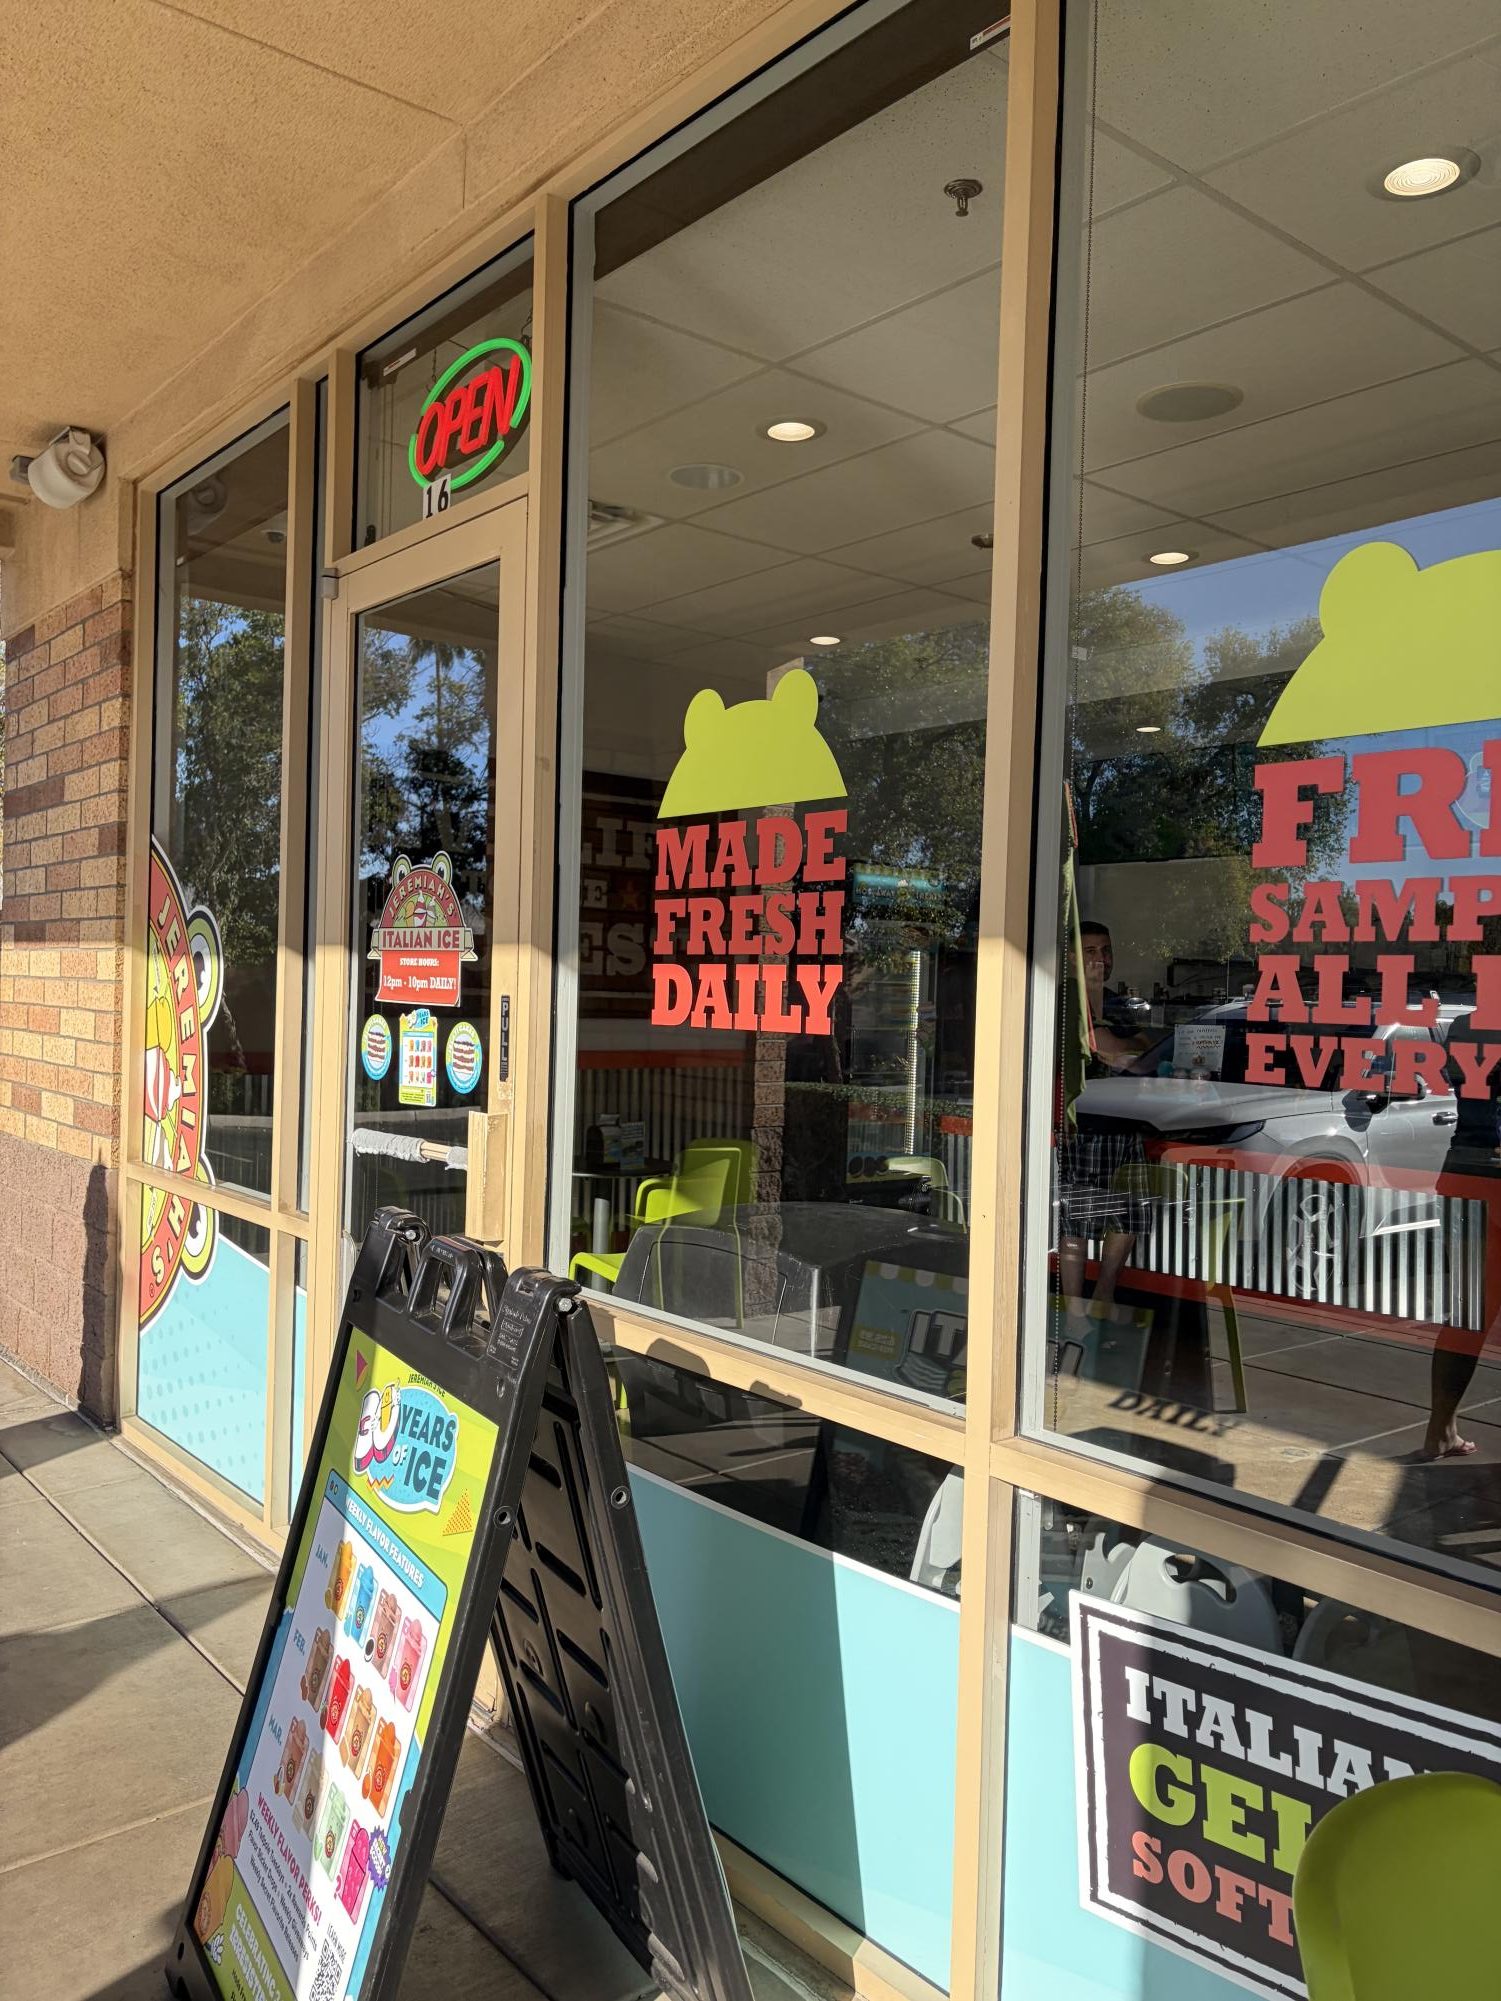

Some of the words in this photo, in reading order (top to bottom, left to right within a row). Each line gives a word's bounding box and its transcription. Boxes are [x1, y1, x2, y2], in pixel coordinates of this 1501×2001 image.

[416, 354, 521, 476] OPEN
[426, 479, 449, 518] 16
[655, 809, 848, 891] MADE
[388, 875, 454, 918] JEREMIAH'S
[653, 891, 845, 956] FRESH
[383, 930, 432, 949] ITALIAN
[438, 930, 459, 949] ICE
[400, 957, 418, 966] STORE
[383, 975, 402, 990] 12pm
[408, 976, 428, 992] 10pm
[430, 976, 457, 990] DAILY!
[651, 963, 843, 1036] DAILY
[1245, 954, 1441, 1029] ALL
[401, 1403, 456, 1452] YEARS
[392, 1444, 408, 1466] OF
[404, 1446, 446, 1500] ICE
[366, 1519, 390, 1555] FLAVOR
[389, 1543, 425, 1590] FEATURES
[257, 1791, 279, 1839] WEEKLY
[277, 1832, 300, 1883] FLAVOR
[299, 1874, 322, 1926] PERKS!
[1132, 1831, 1293, 1947] SOFT
